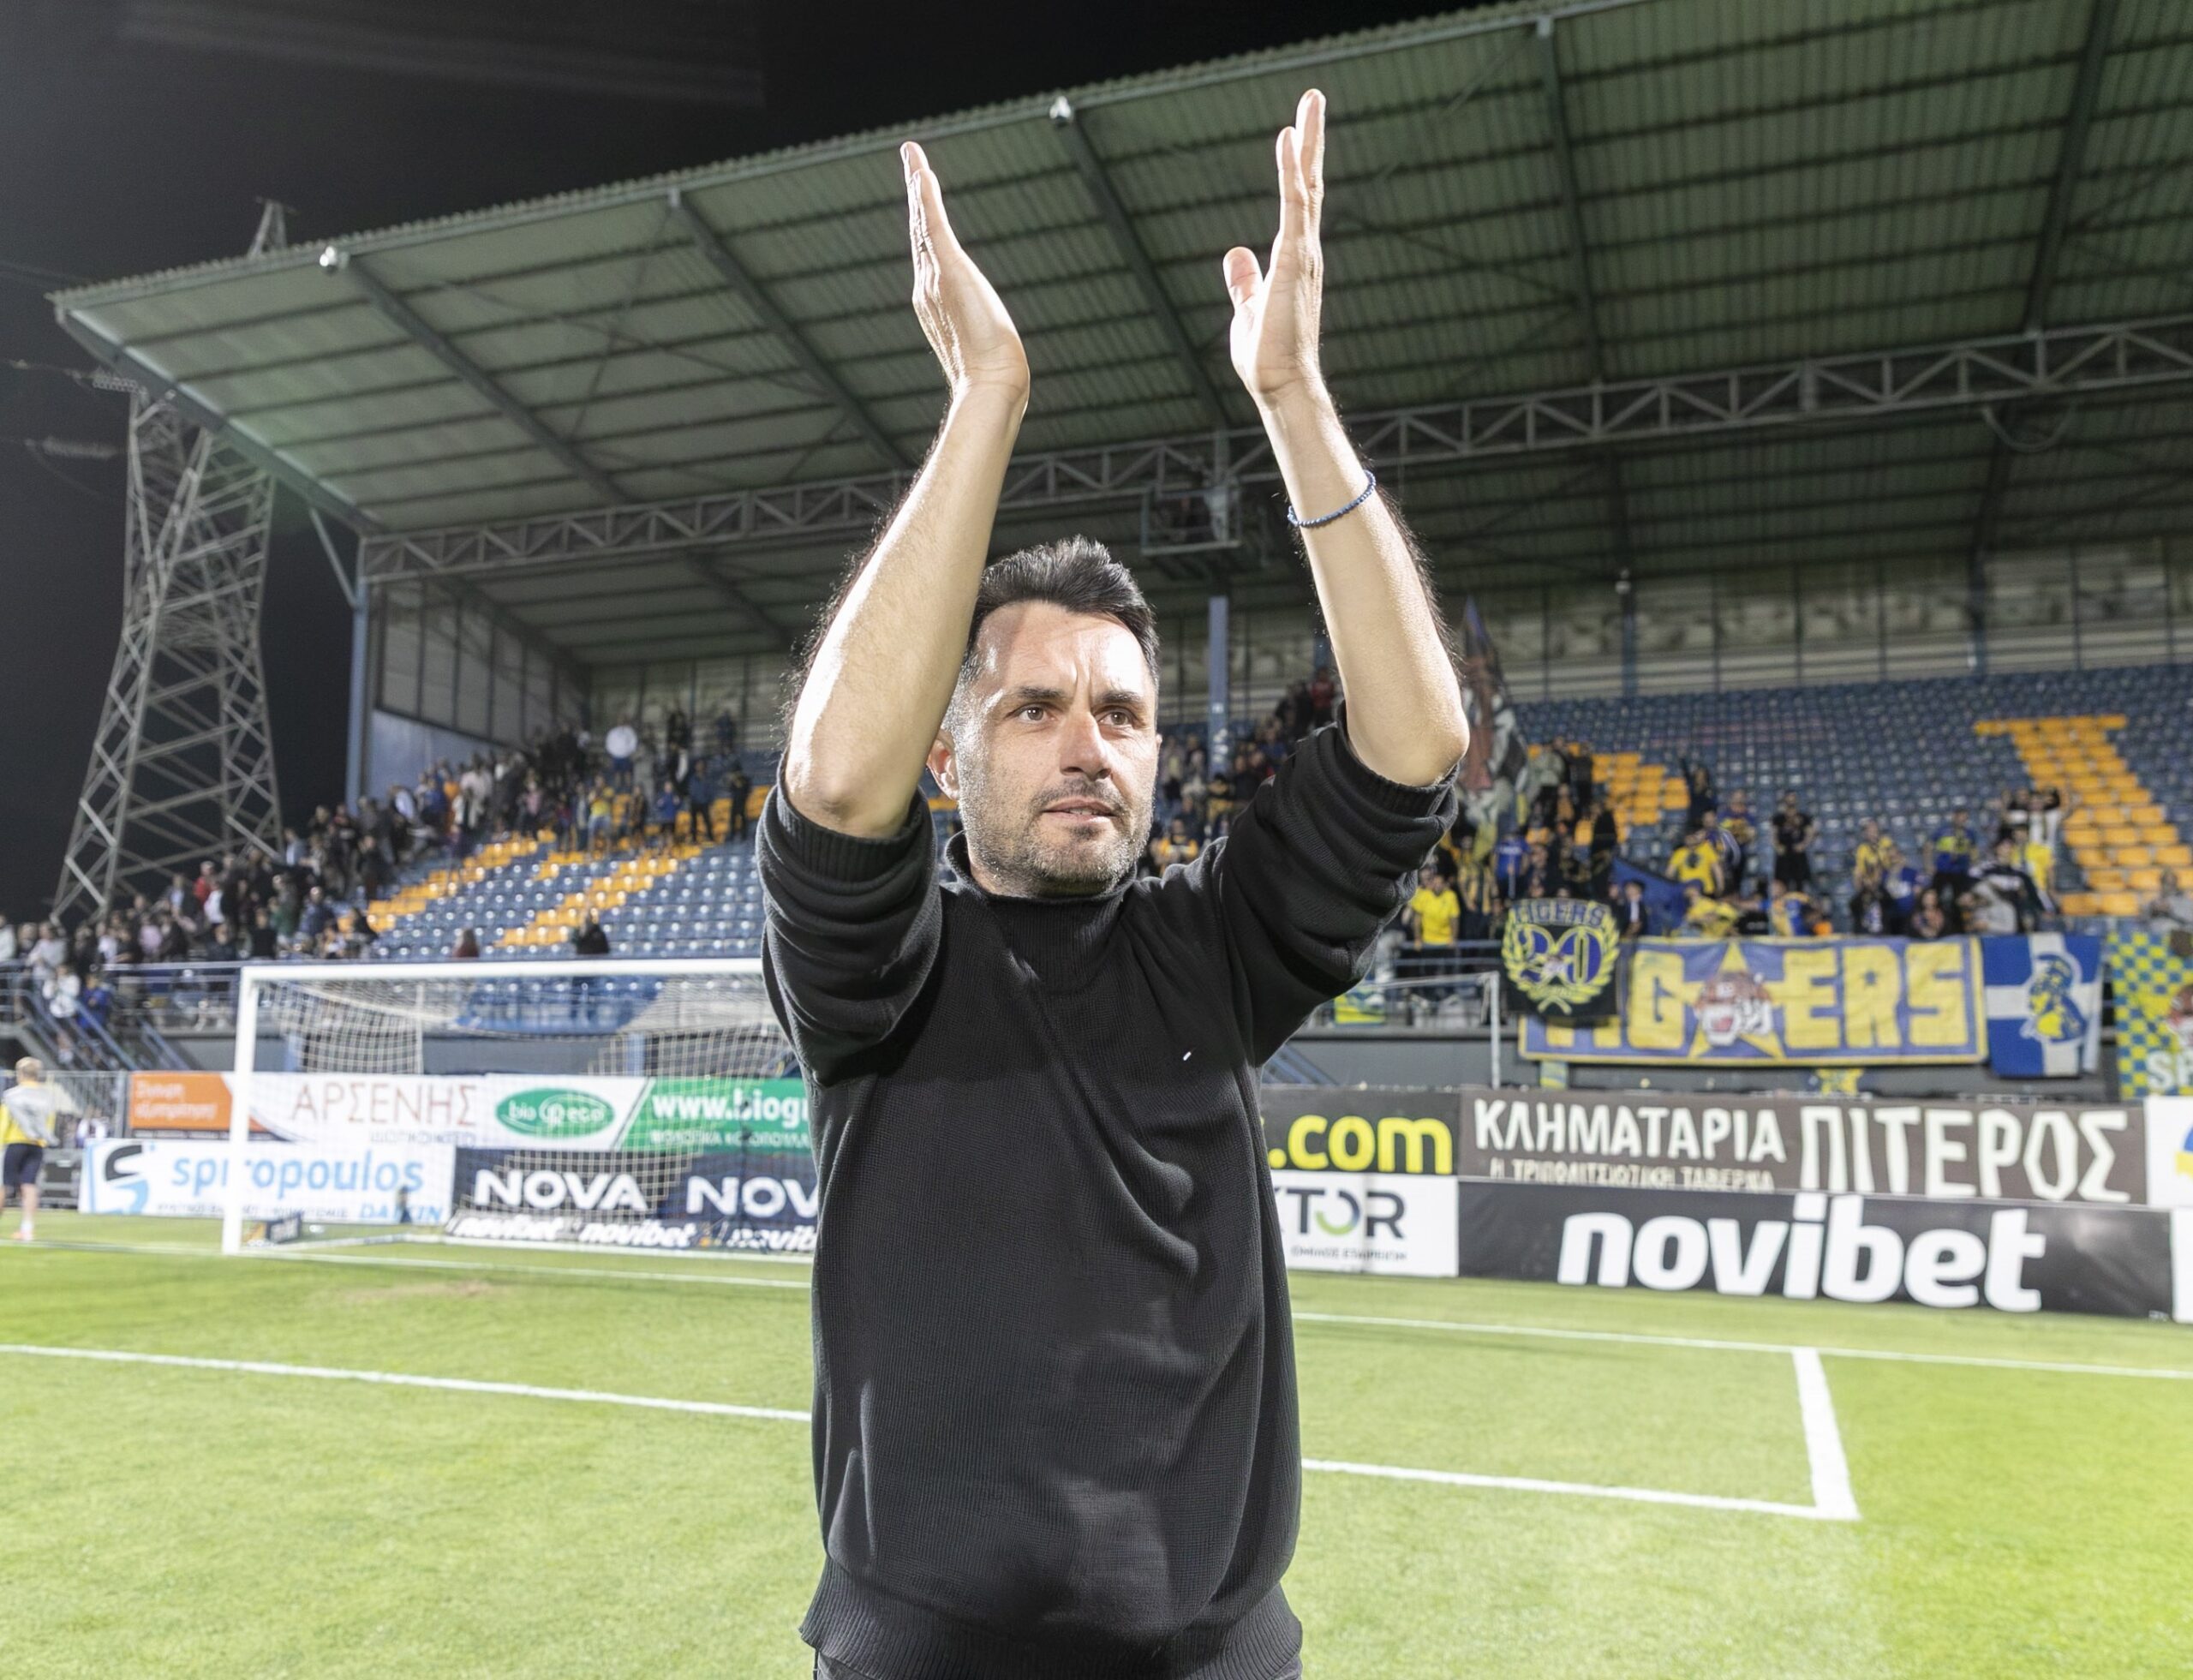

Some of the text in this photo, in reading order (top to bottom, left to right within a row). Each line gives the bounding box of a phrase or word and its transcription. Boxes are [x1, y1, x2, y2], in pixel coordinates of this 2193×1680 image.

[291, 1081, 476, 1127] ΑΡΣΕΝΗΣ
[1473, 1098, 1787, 1163] ΚΛΗΜΑΤΑΡΙΑ
[1801, 1106, 2130, 1201] ΠΙΤΕΡΟΣ
[170, 1151, 423, 1198] spiopoulos
[473, 1169, 648, 1211] NOVA
[578, 1218, 696, 1247] novibet
[1558, 1192, 2047, 1312] novibet
